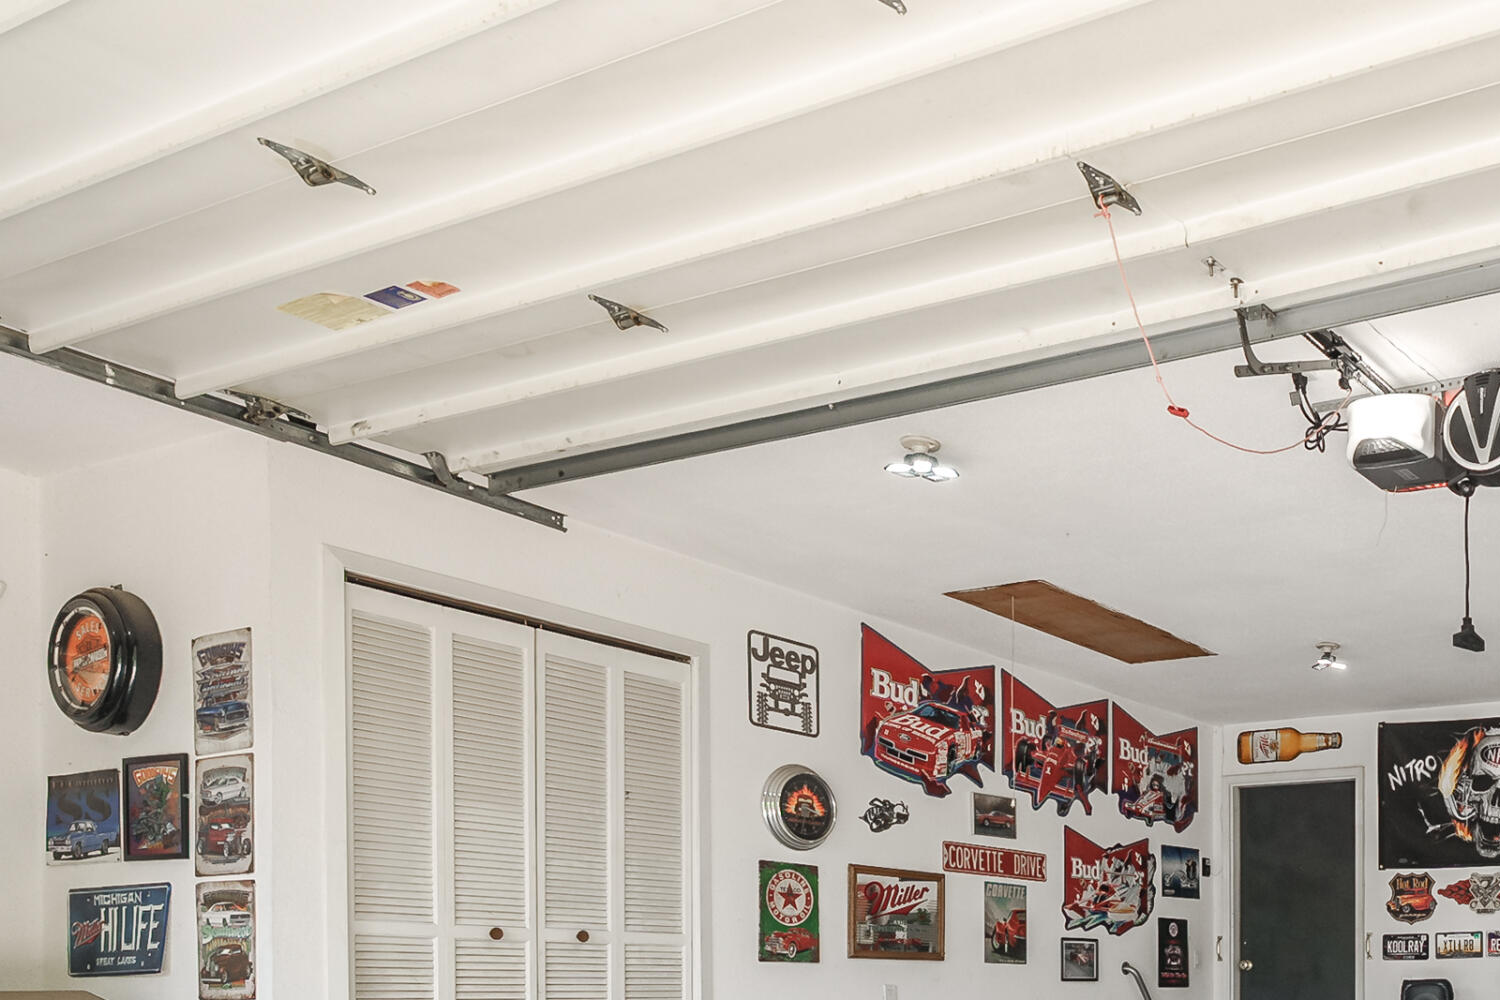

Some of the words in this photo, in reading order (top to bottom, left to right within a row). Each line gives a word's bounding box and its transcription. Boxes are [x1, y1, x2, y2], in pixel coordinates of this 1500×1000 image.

[751, 636, 816, 675] Jeep
[870, 667, 919, 707] Bud
[887, 715, 951, 740] Bud
[1010, 708, 1047, 740] Bud
[1119, 737, 1148, 766] Bud
[1387, 755, 1438, 791] NITRO
[948, 845, 1005, 874] CORVETTE
[1013, 853, 1042, 878] DRIVE
[1071, 857, 1100, 880] Bud
[93, 892, 142, 906] MICHIGAN
[864, 881, 930, 916] Miller
[986, 883, 1026, 899] CORVETTE
[1387, 940, 1424, 953] KOOLRAY
